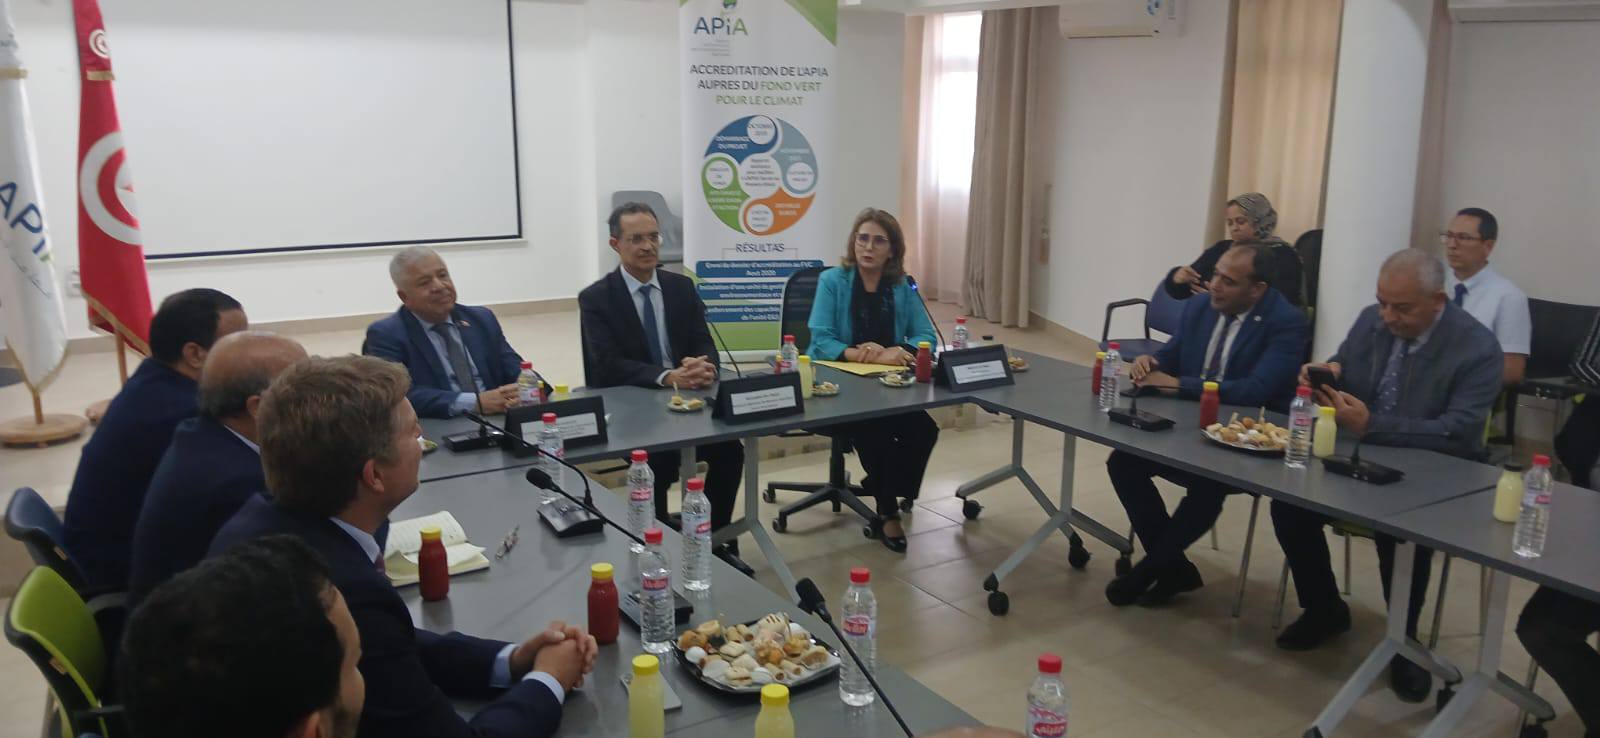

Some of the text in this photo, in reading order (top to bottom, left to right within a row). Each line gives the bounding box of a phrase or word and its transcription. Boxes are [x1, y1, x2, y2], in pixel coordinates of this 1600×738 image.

[690, 64, 829, 77] ACCREDITATION DE L'APIA
[698, 80, 822, 92] AUPRES DU FOND VERT
[716, 95, 804, 106] POUR LE CLIMAT
